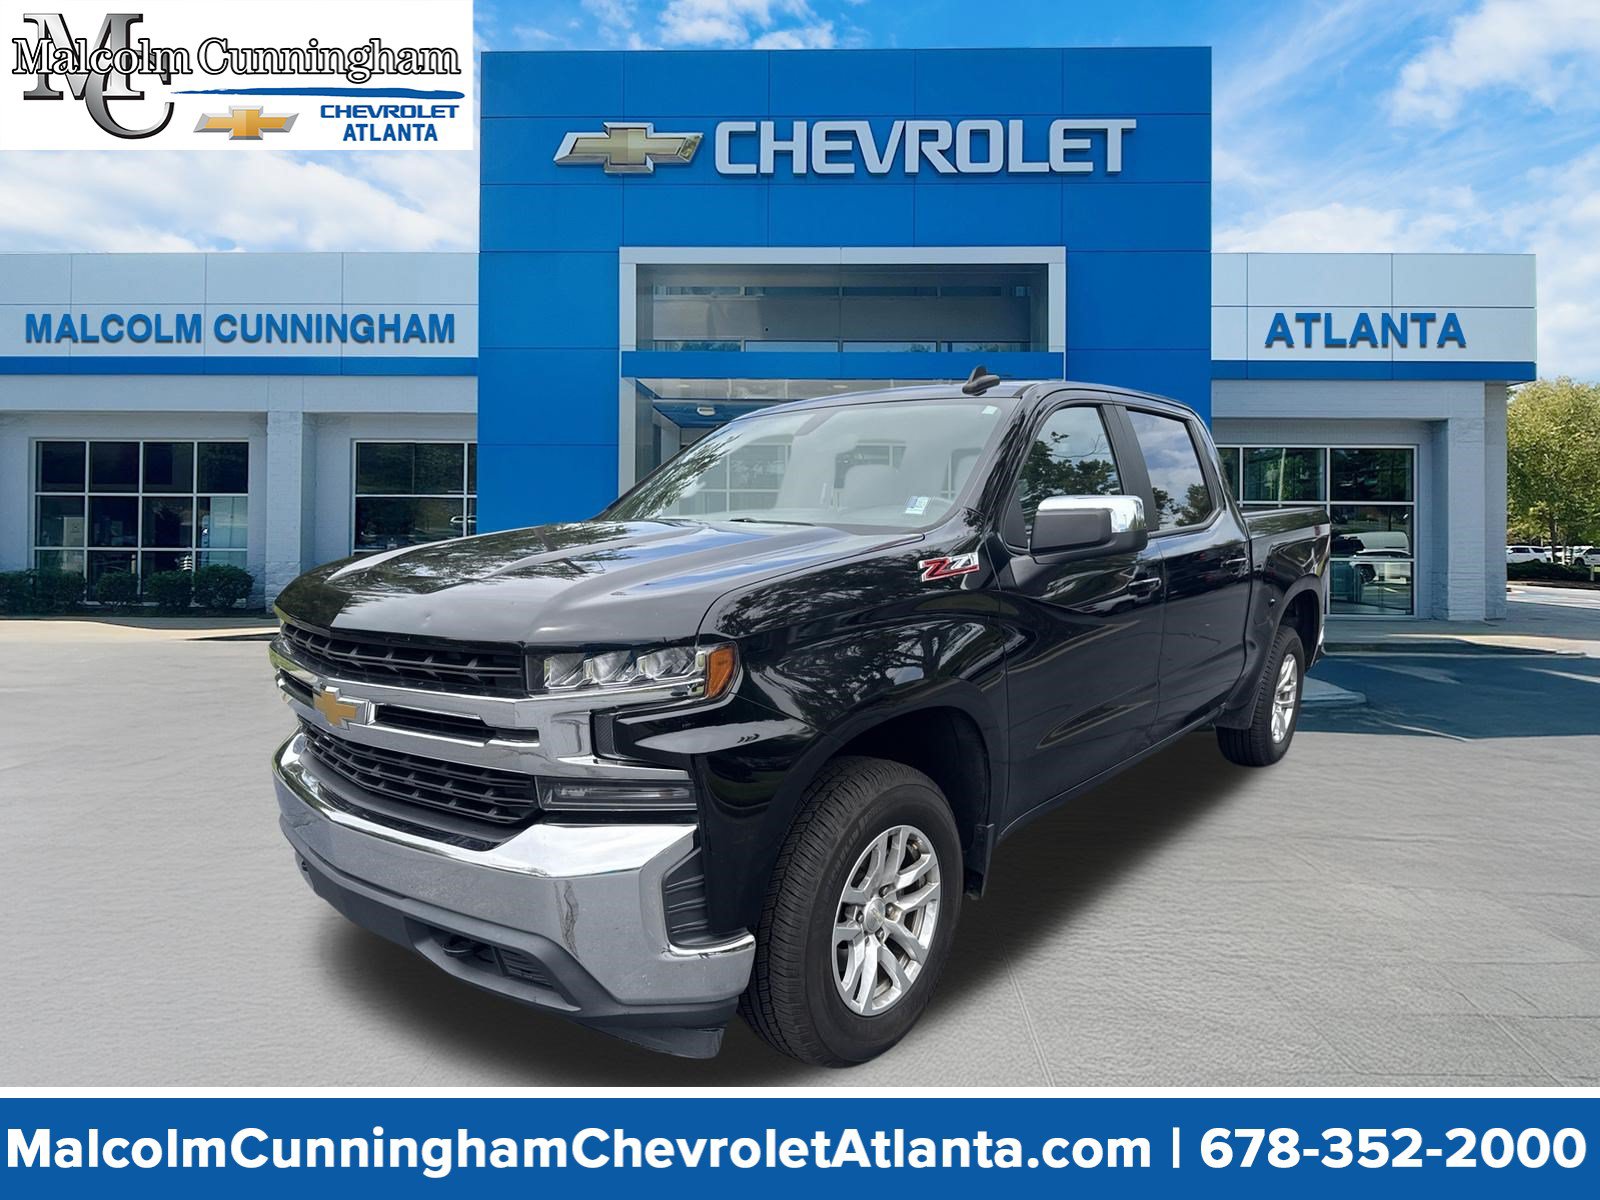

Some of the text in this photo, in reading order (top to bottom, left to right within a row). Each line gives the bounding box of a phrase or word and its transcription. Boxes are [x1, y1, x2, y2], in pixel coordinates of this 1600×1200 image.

[715, 119, 1137, 174] CHEVROLET
[25, 313, 455, 344] MALCOLM CUNNINGHAM
[1264, 312, 1467, 349] ATLANTA
